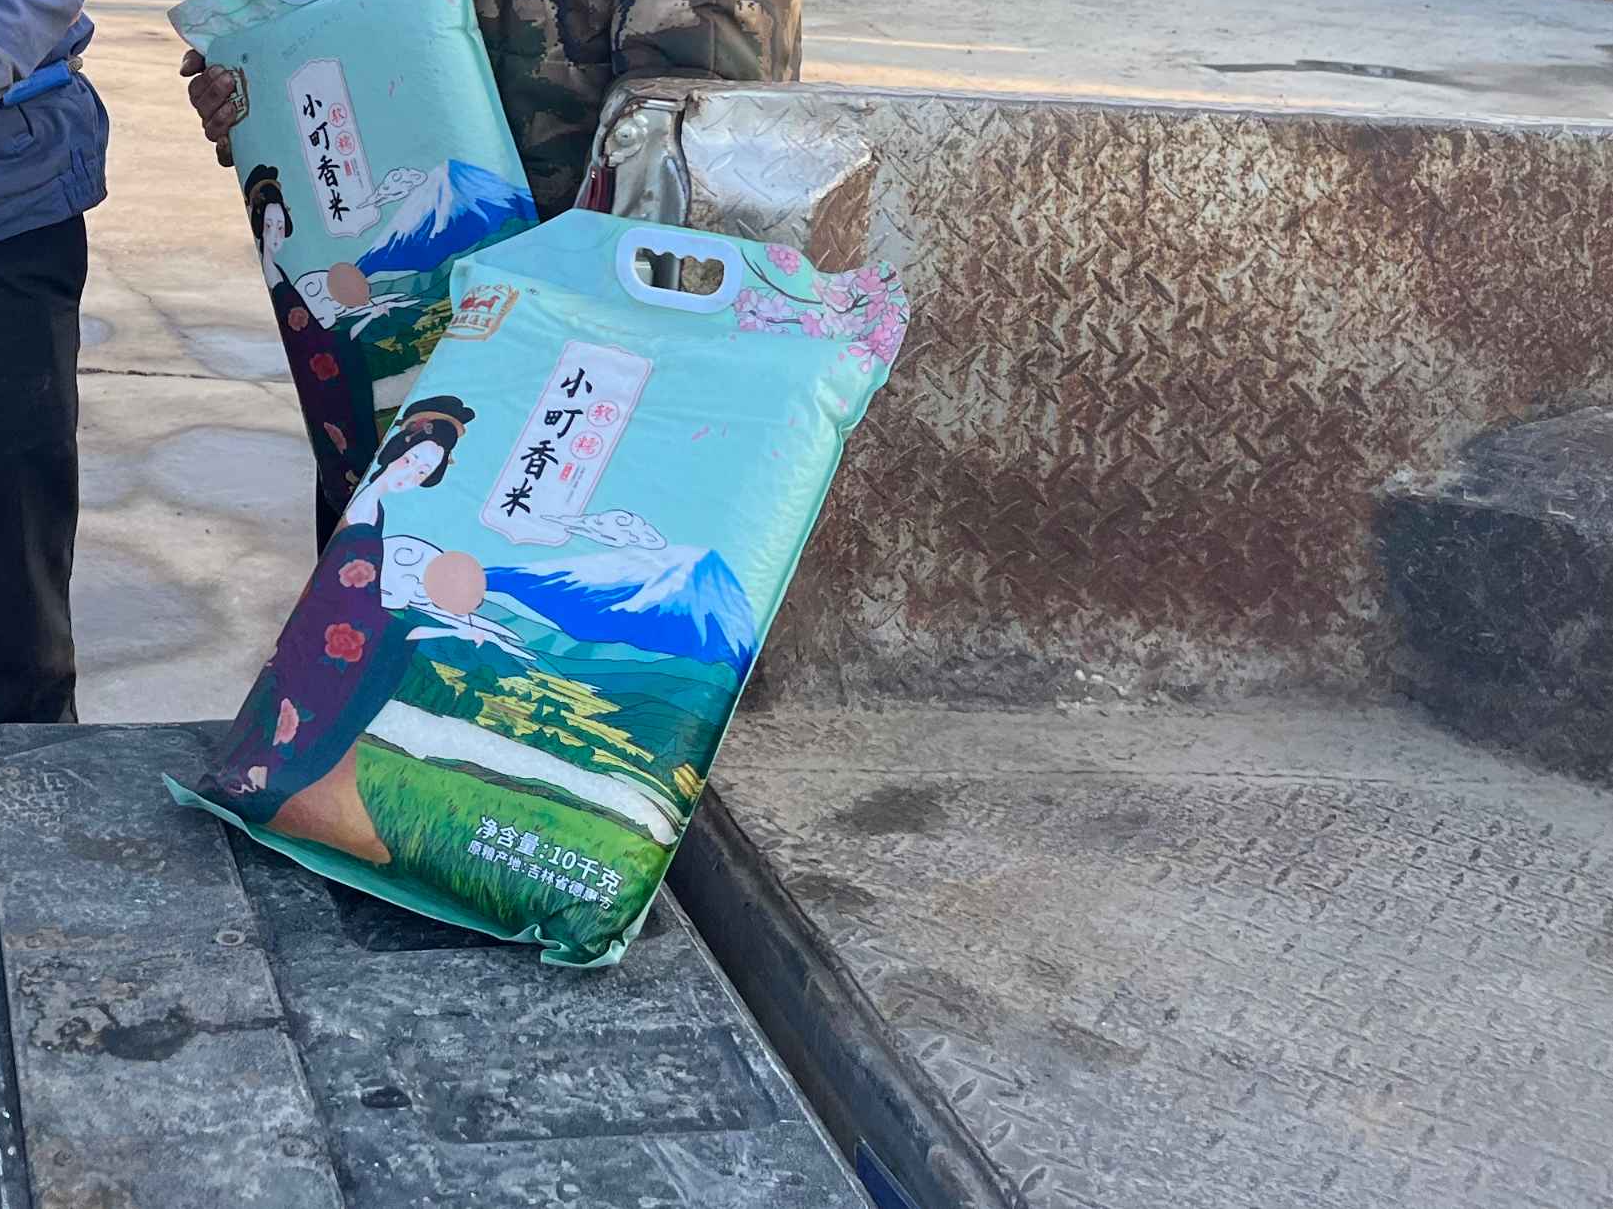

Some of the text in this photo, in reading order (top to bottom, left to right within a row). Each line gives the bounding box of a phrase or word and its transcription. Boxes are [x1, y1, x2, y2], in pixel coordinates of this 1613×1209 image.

[302, 93, 350, 222] 小町香米
[500, 367, 593, 517] 小町香米
